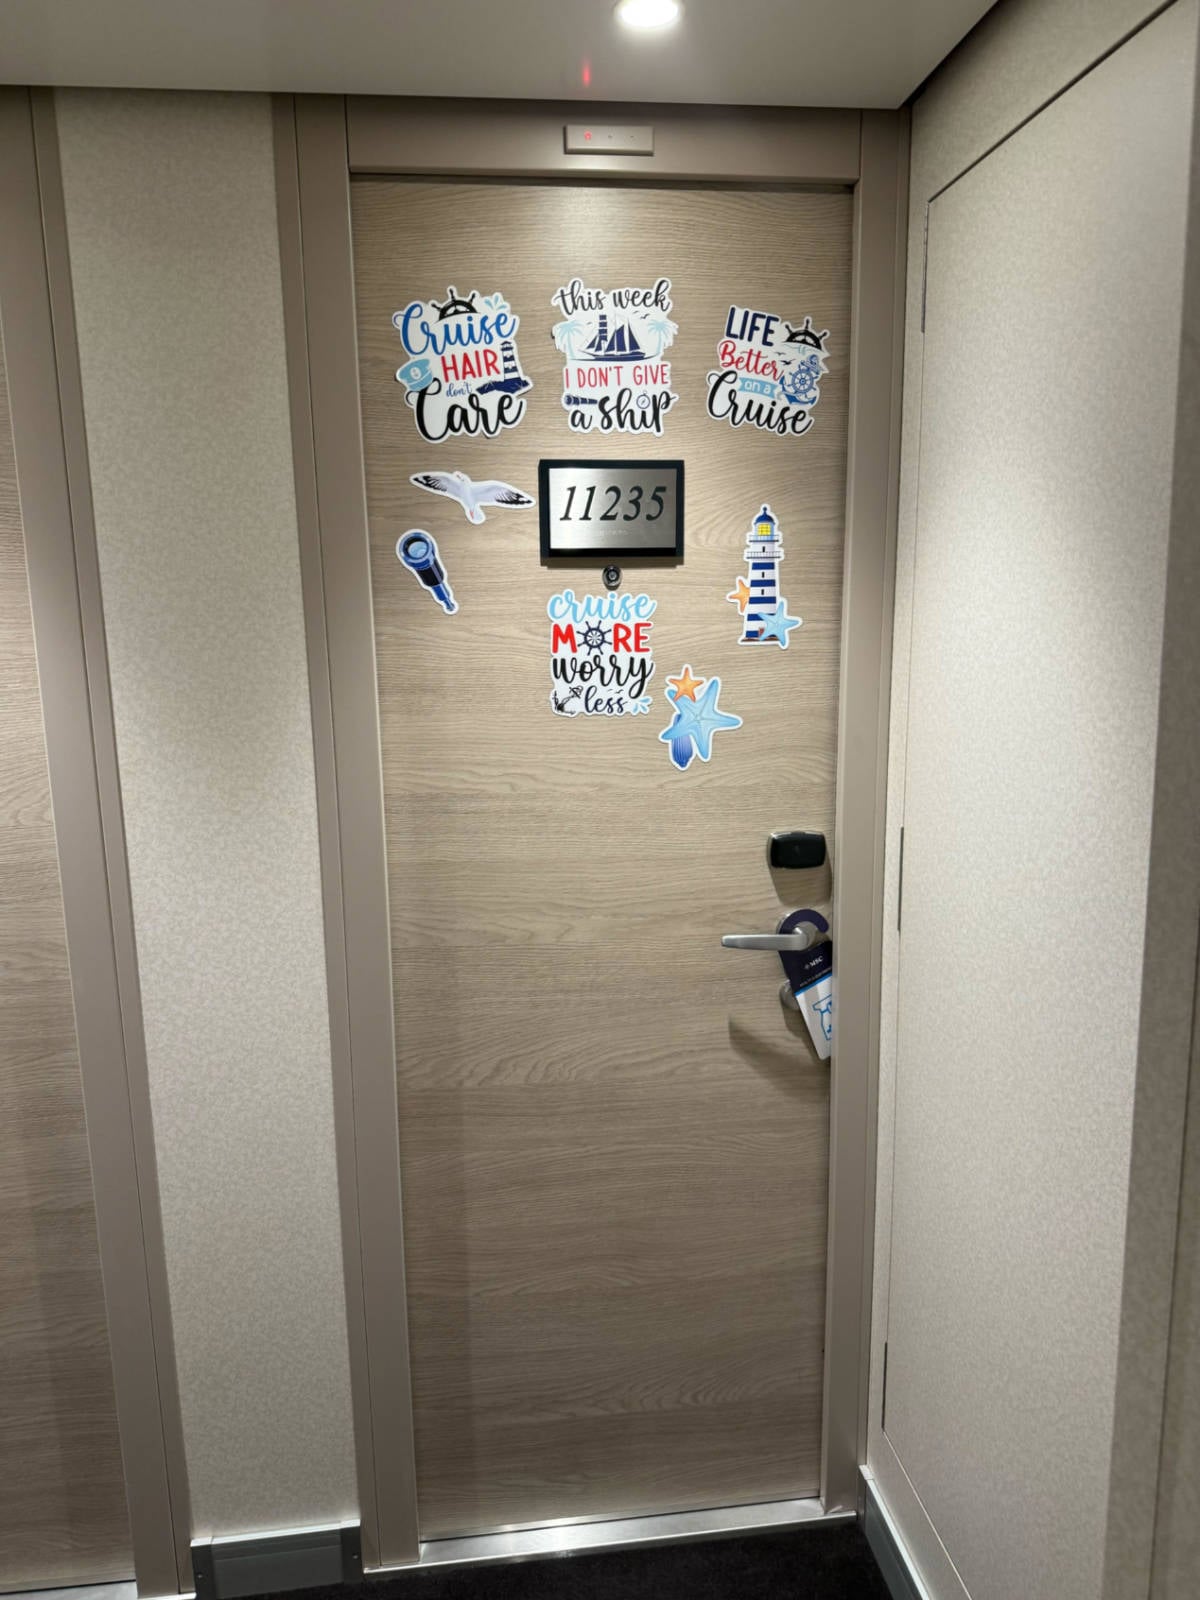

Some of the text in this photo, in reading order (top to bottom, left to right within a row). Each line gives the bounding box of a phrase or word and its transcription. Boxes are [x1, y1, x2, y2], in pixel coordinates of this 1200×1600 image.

[554, 280, 670, 315] this week
[394, 303, 516, 355] Cruise
[726, 307, 779, 347] LIFE
[441, 349, 500, 383] HAIR
[565, 364, 669, 388] I DON'T GIVE
[719, 340, 784, 381] Better
[446, 382, 472, 397] don't
[708, 370, 813, 434] Cruise
[744, 381, 771, 393] on a
[405, 378, 523, 440] Care
[571, 388, 677, 433] a ship
[560, 485, 667, 521] 11235
[549, 591, 656, 624] cruise
[553, 655, 654, 699] worry
[584, 685, 628, 714] less
[809, 955, 824, 968] MSC
